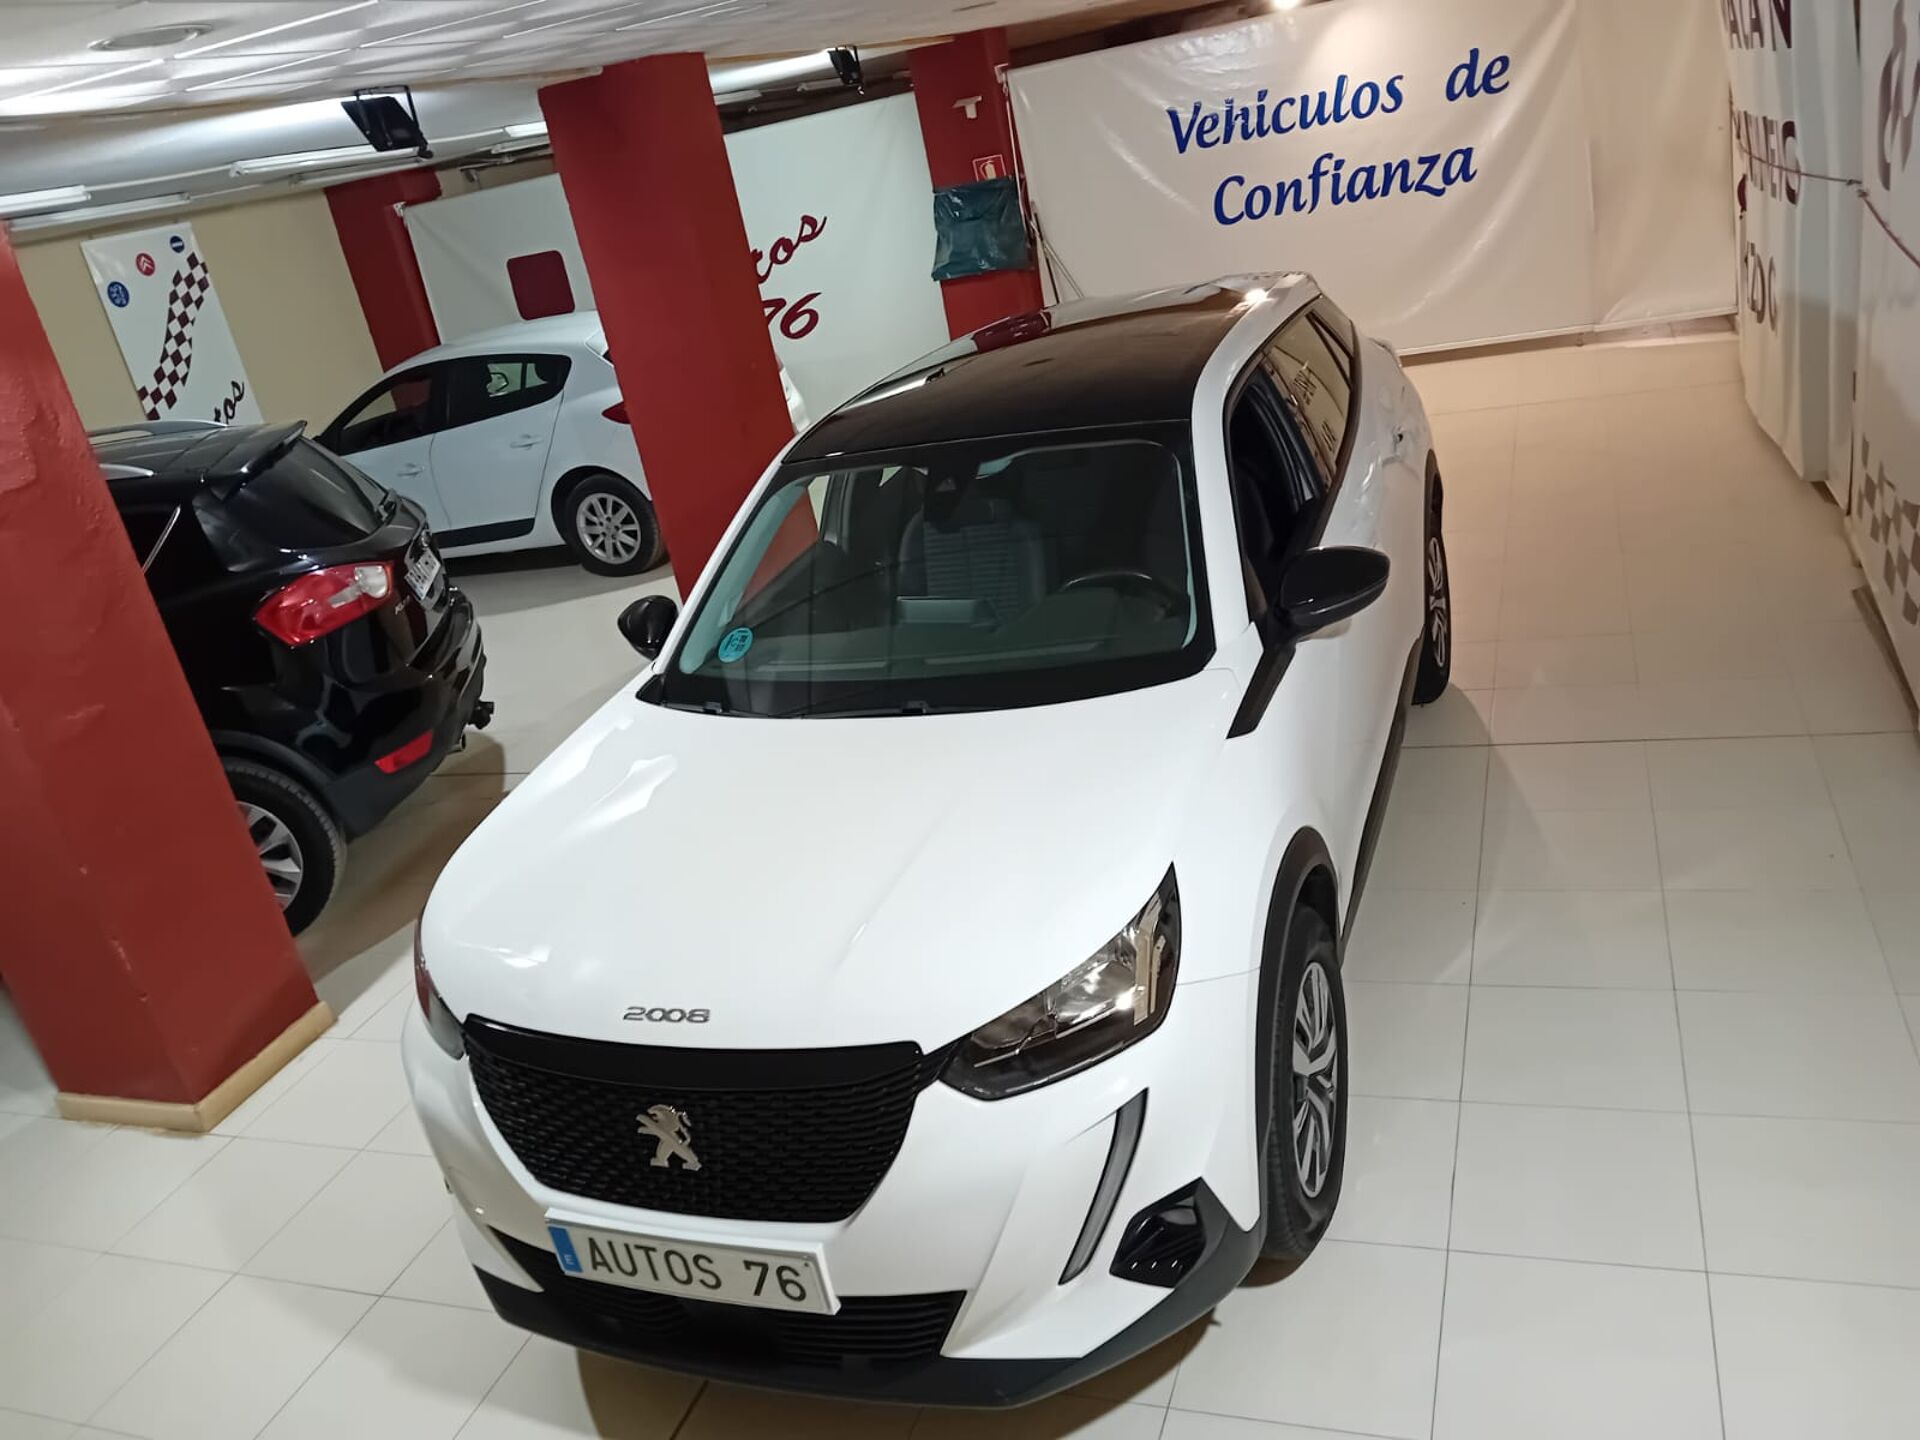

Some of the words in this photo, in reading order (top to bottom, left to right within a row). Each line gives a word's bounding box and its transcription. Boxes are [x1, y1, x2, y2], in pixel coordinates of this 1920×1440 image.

[1445, 47, 1510, 102] de
[1213, 146, 1477, 226] Confianza
[622, 1005, 711, 1024] 2008
[587, 1236, 723, 1291] AUTOS
[742, 1259, 808, 1303] 76
